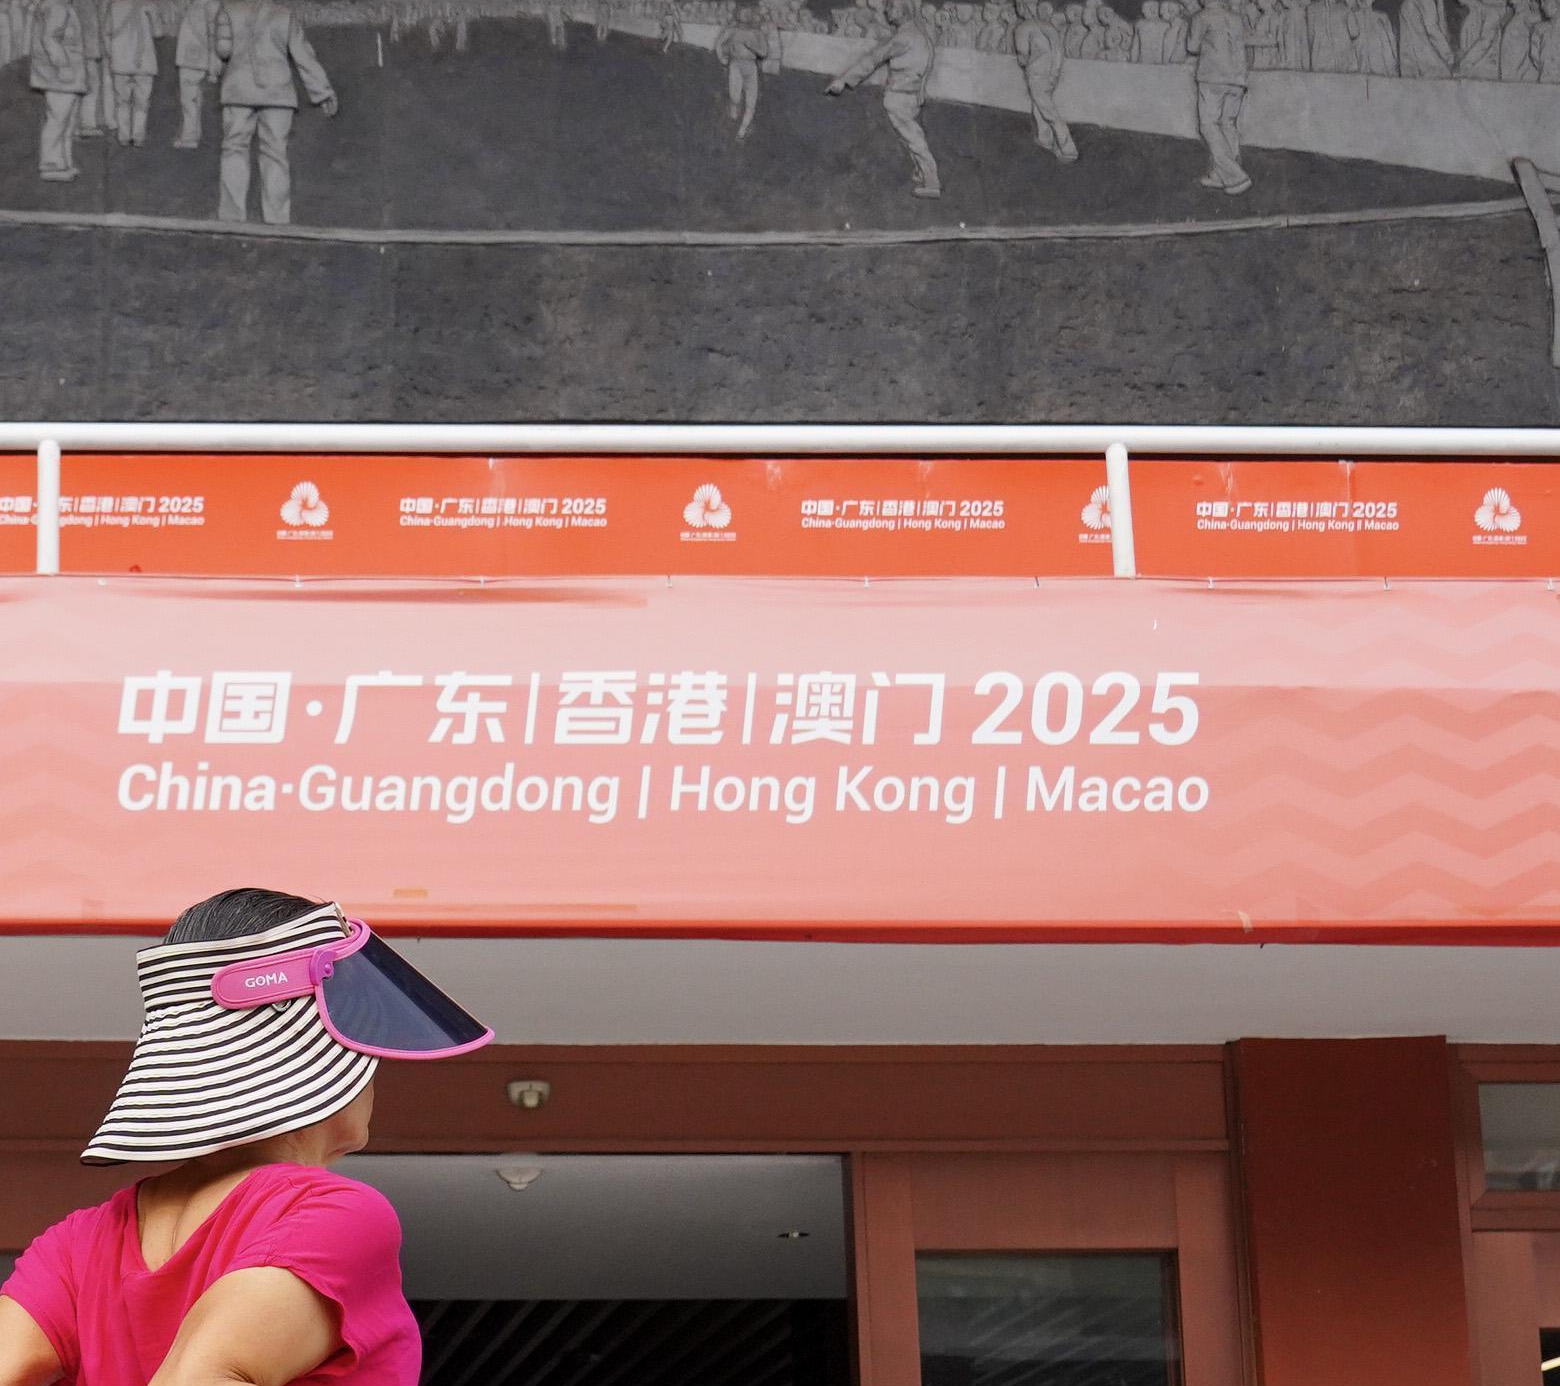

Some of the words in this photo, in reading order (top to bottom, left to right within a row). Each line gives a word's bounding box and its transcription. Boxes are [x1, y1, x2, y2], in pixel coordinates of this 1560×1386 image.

[160, 497, 204, 513] 2025
[562, 498, 606, 514] 2025
[960, 501, 1003, 516] 2025
[1354, 502, 1397, 518] 2025
[505, 516, 532, 528] Hong
[536, 516, 562, 528] Kong
[572, 516, 607, 526] Macao
[905, 518, 931, 530] Hong
[935, 518, 961, 531] Kong
[971, 518, 1005, 528] Macao
[1299, 520, 1326, 532] Hong
[1329, 520, 1355, 532] Kong
[1365, 520, 1399, 530] Macao
[971, 668, 1201, 746] 2025
[670, 765, 816, 824] Hong
[835, 765, 976, 825] Kong
[1026, 765, 1209, 813] Macao
[244, 971, 288, 988] GOMA
